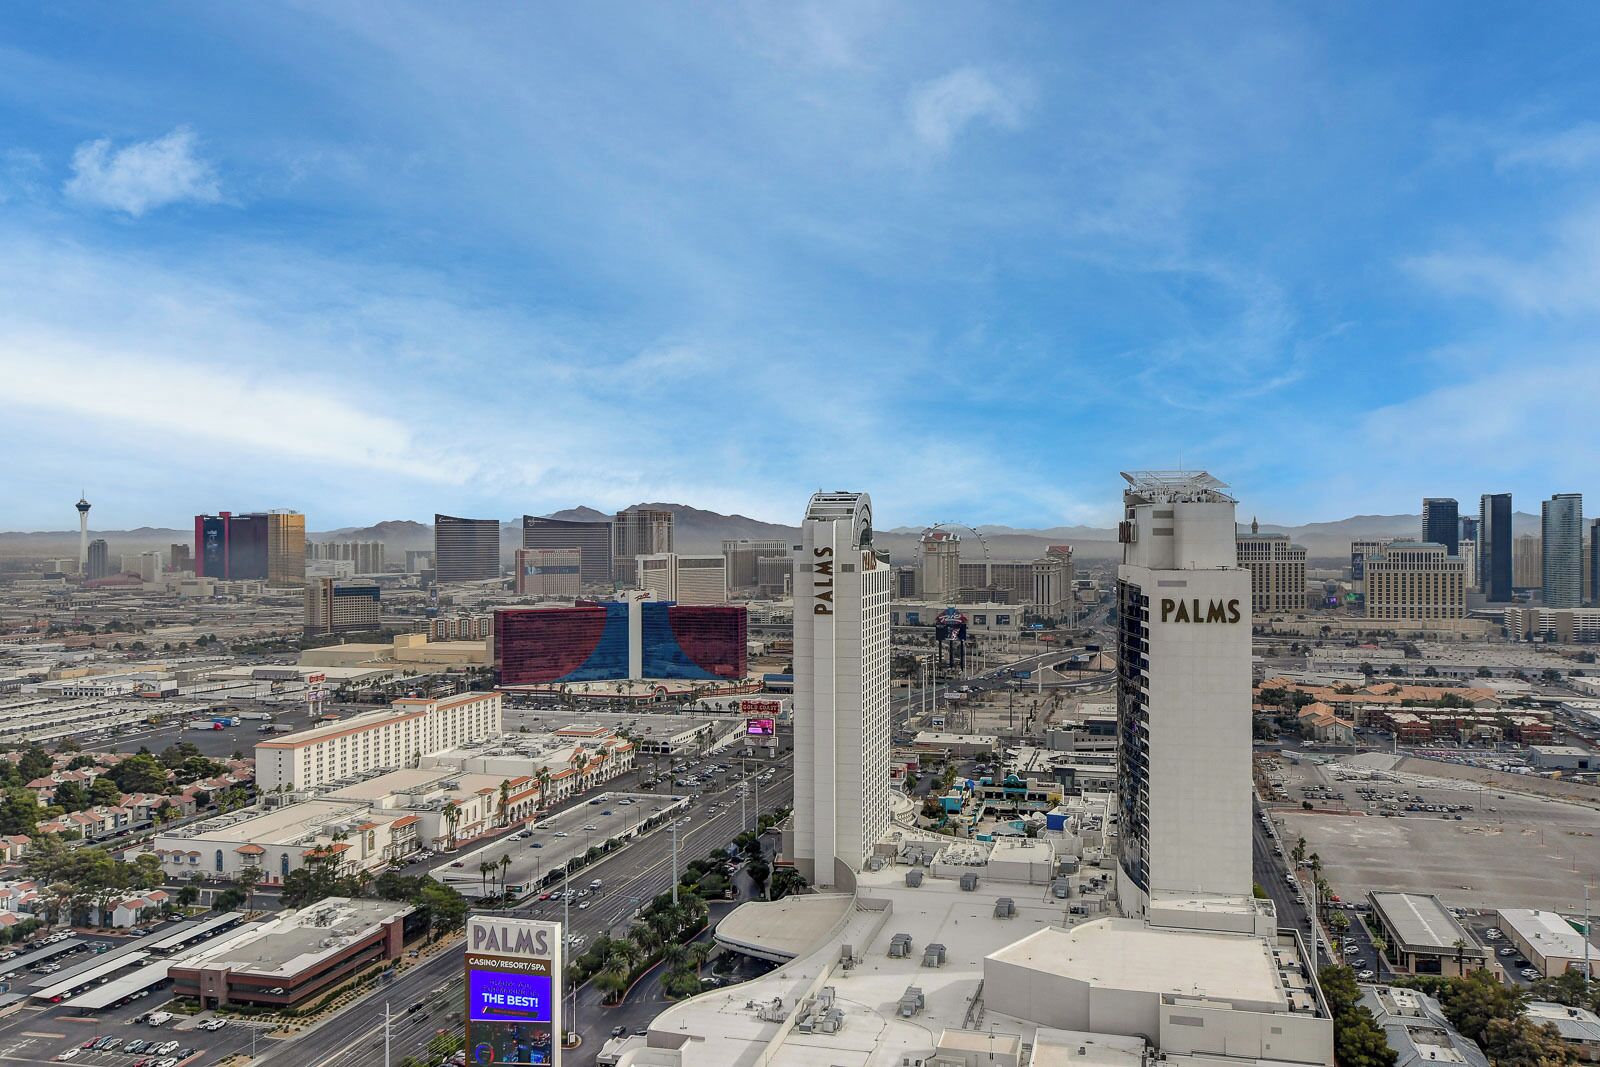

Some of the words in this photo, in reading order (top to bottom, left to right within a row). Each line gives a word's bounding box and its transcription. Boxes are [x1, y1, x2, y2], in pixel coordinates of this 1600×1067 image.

[814, 547, 833, 614] PALMS
[1161, 598, 1241, 623] PALMS
[473, 924, 547, 955] PALMS
[469, 958, 546, 971] CASINO/RESORT/SPA
[482, 993, 505, 1004] THE
[507, 995, 539, 1007] BEST!
